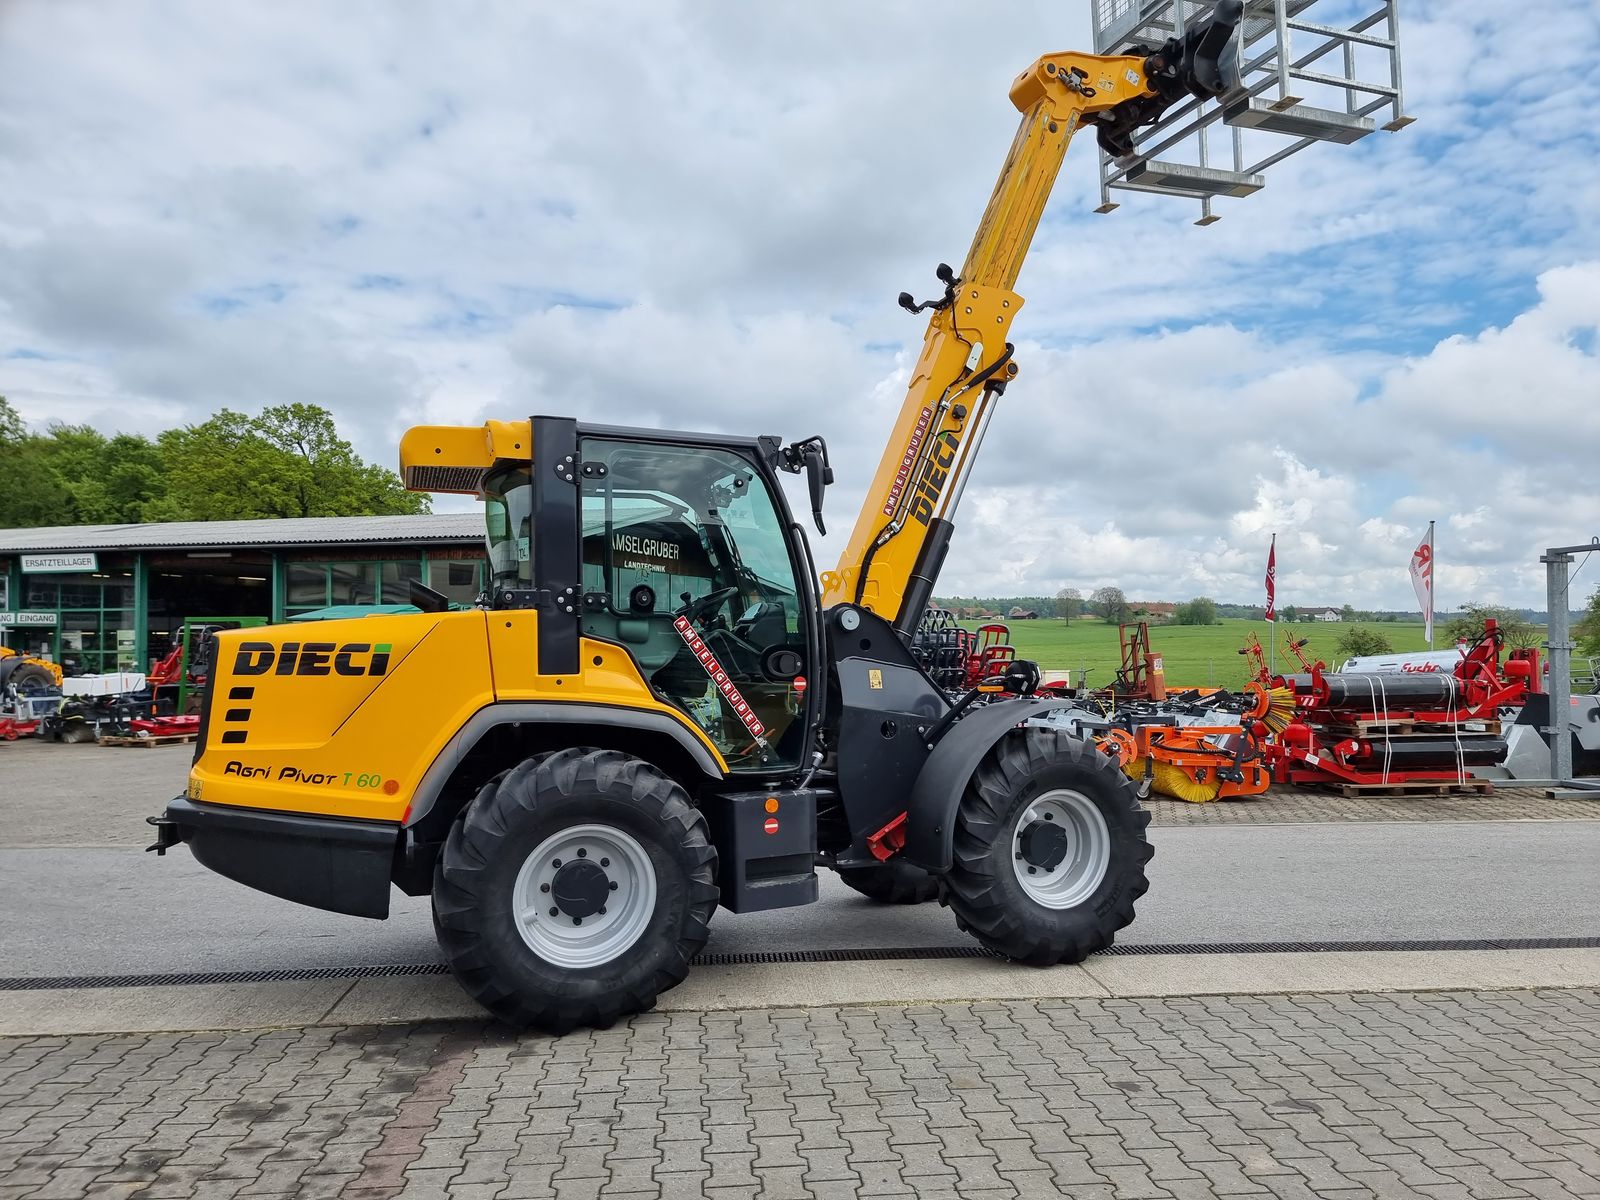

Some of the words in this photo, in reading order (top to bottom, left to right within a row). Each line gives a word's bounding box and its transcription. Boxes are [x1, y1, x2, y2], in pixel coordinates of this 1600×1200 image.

[25, 557, 92, 568] ERSATZTEILLAGER
[624, 560, 666, 573] LANDTECHNIK
[20, 614, 55, 622] EINGANG
[1401, 661, 1440, 673] Fuchs
[343, 771, 353, 786] T
[356, 773, 381, 788] 60
